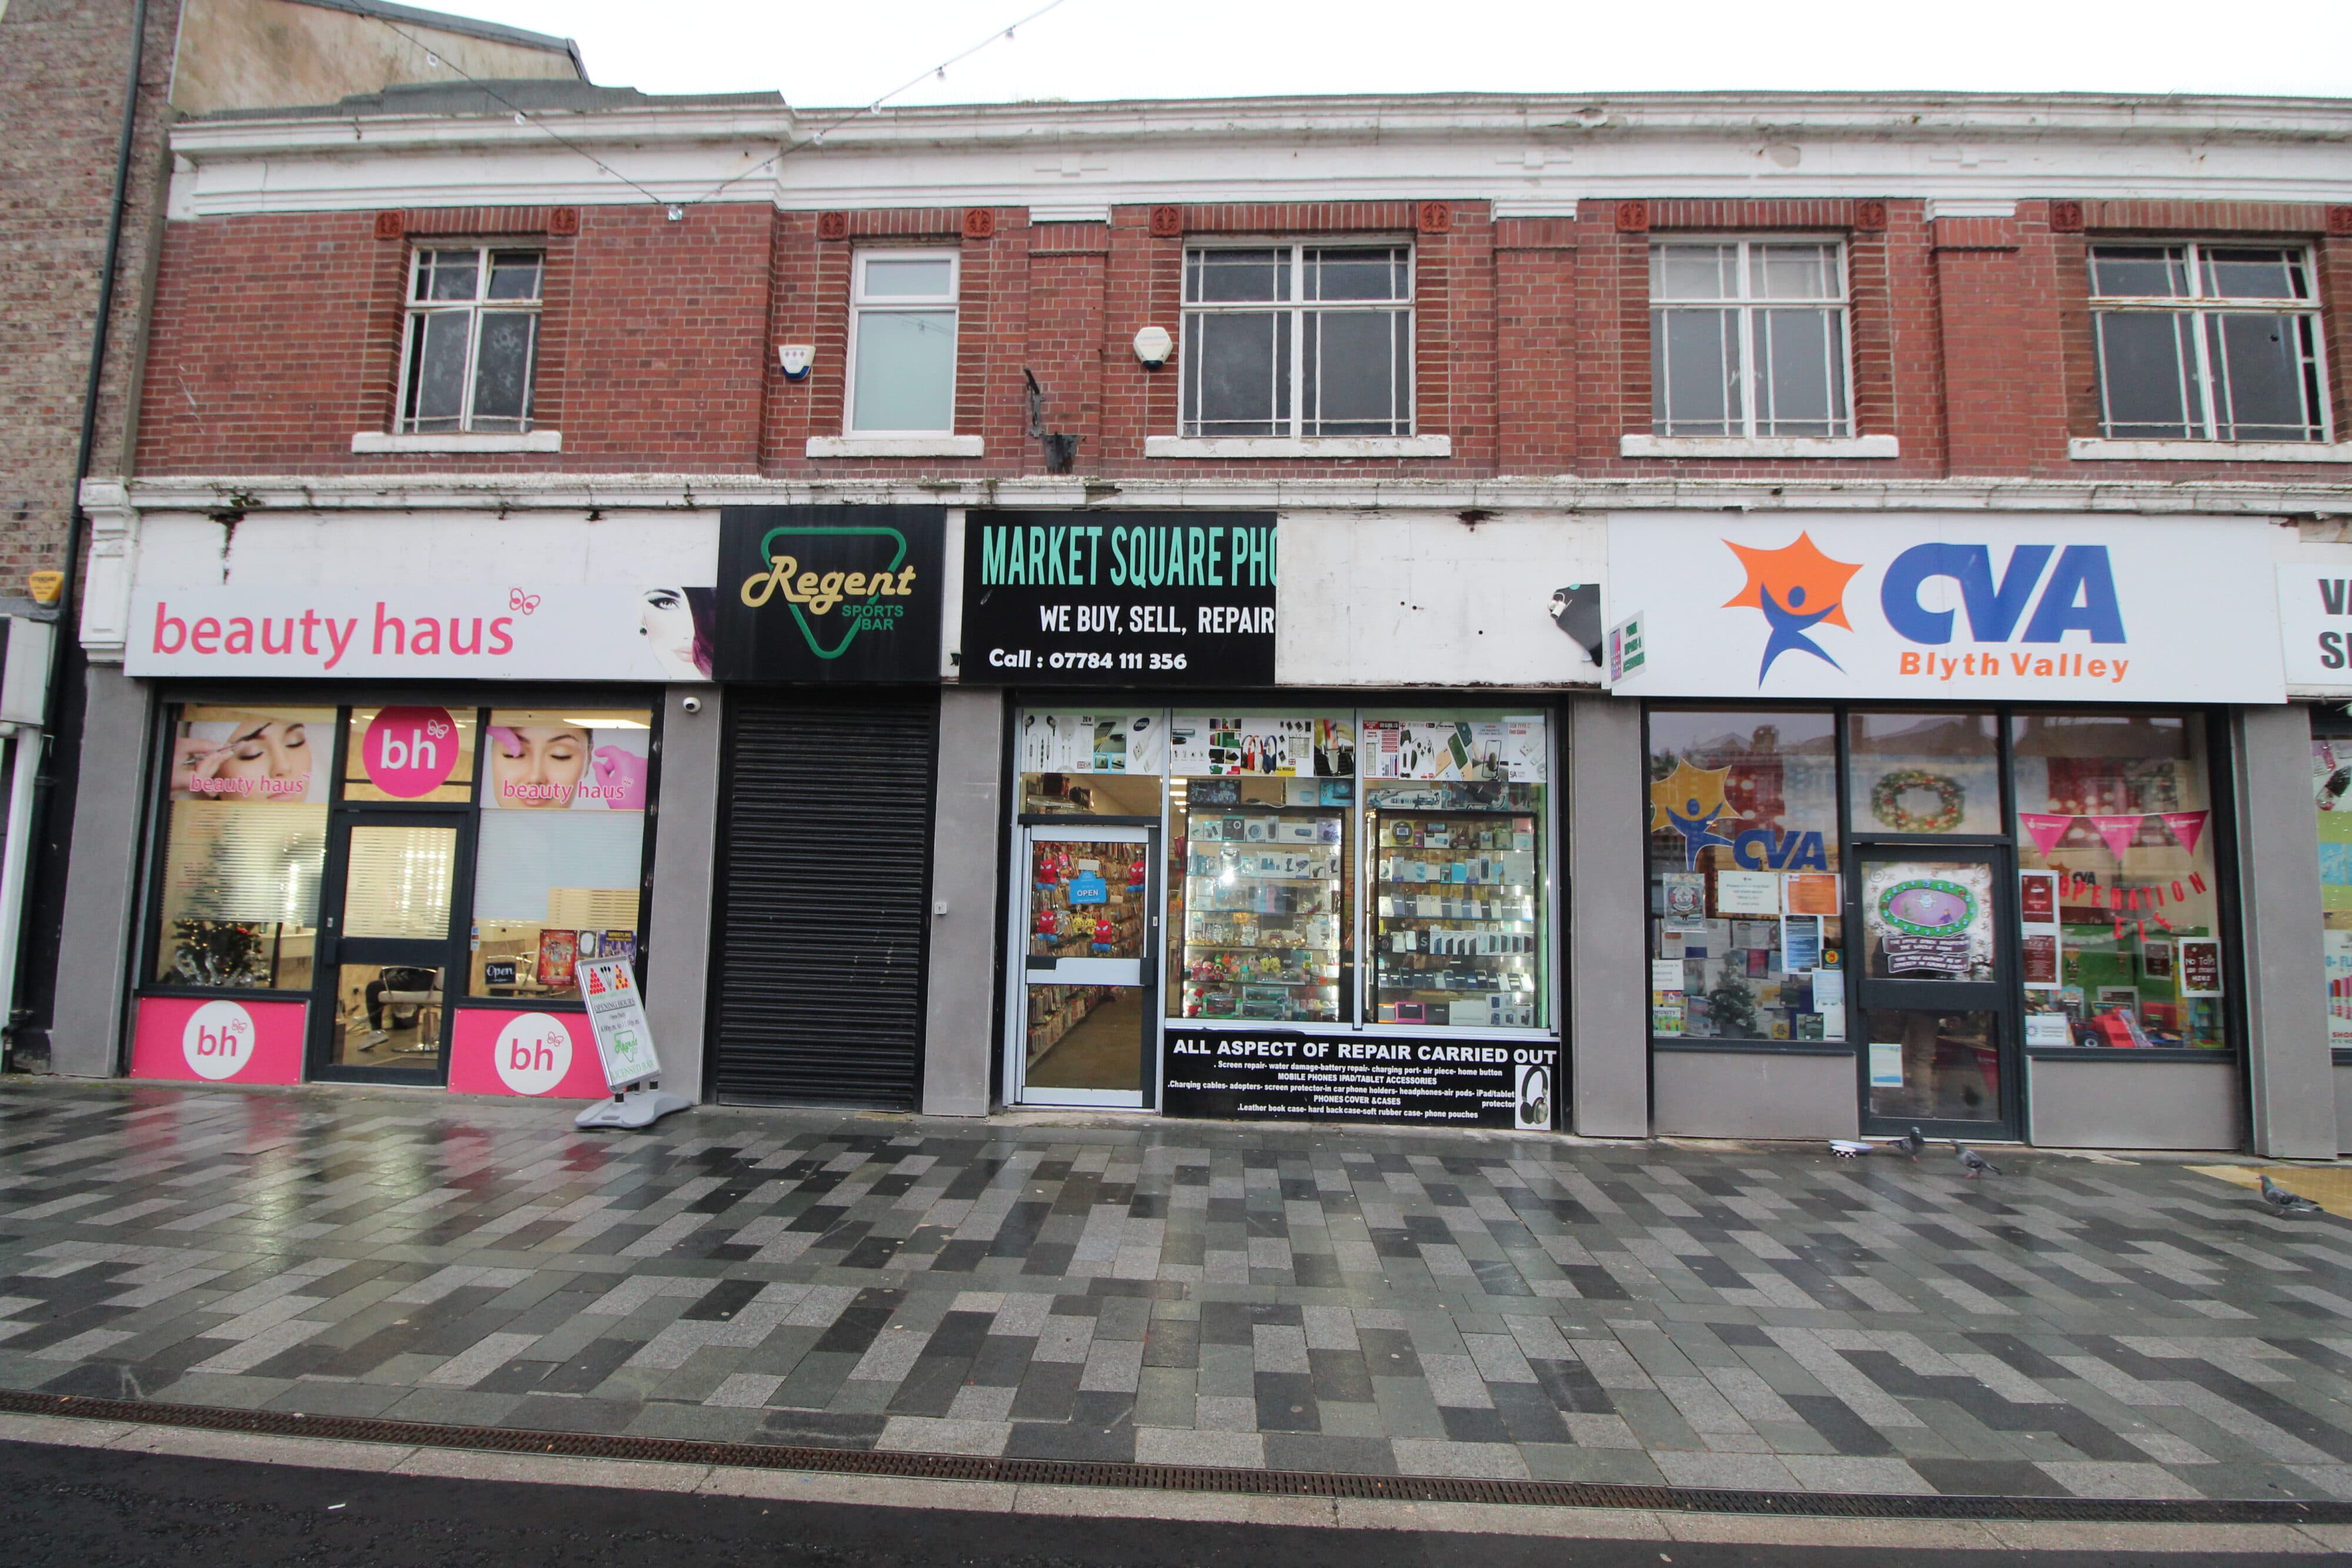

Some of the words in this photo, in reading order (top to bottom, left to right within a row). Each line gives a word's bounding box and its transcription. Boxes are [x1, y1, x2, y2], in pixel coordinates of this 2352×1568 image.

[982, 526, 1103, 586] MARKET
[1110, 526, 1224, 589] SQUARE
[741, 555, 917, 616] Regent
[1880, 542, 2127, 646] CVA
[842, 604, 904, 617] SPORTS
[1040, 605, 1071, 633] WE
[1077, 606, 1122, 635] BUY,
[1130, 606, 1187, 636] SELL,
[1198, 607, 1275, 634] REPAIR
[152, 601, 358, 670] beauty
[372, 601, 514, 656] haus
[862, 618, 894, 631] BAR
[989, 648, 1031, 668] Call
[1049, 652, 1113, 670] 07784
[1119, 653, 1142, 670] 111
[1149, 653, 1187, 670] 356
[1900, 651, 1999, 681] Blyth
[2010, 653, 2129, 683] Valley
[381, 729, 436, 770] bh
[190, 774, 255, 795] beauty
[260, 774, 303, 793] haus
[503, 780, 572, 803] beauty
[578, 781, 624, 799] haus
[1733, 828, 1828, 871] CVA
[486, 965, 514, 978] Open
[594, 1001, 617, 1012] OPENING
[617, 997, 635, 1008] HOURS
[197, 1025, 237, 1057] bh
[615, 1038, 637, 1054] Regent
[1173, 1039, 1211, 1054] ALL
[1217, 1041, 1297, 1057] ASPECT
[1303, 1042, 1329, 1058] OF
[1338, 1044, 1412, 1060] REPAIR
[1418, 1045, 1508, 1063] CARRIED
[1513, 1049, 1557, 1065] OUT
[510, 1038, 553, 1071] bh
[1218, 1060, 1242, 1069] Screen
[1244, 1061, 1267, 1071] repair-
[1347, 1065, 1369, 1073] repair-
[1371, 1065, 1402, 1075] charging
[1404, 1066, 1422, 1075] port-
[1434, 1067, 1456, 1076] piece-
[1479, 1068, 1503, 1076] button
[1278, 1072, 1306, 1081] MOBILE
[1307, 1073, 1337, 1082] PHONES
[1339, 1074, 1384, 1084] IPAD/TABLET
[1385, 1076, 1437, 1085] ACCESSORIES
[1202, 1081, 1228, 1089] cables-
[1345, 1085, 1367, 1094] phone
[1369, 1086, 1398, 1095] holders-
[1455, 1089, 1475, 1098] pods-
[1476, 1089, 1515, 1098] iPad/tablet
[1313, 1095, 1344, 1103] PHONES
[1344, 1095, 1369, 1104] COVER
[1371, 1096, 1401, 1105] &CASES
[1268, 1104, 1286, 1112] book
[1308, 1105, 1324, 1114] hard
[1326, 1105, 1344, 1114] back
[1378, 1108, 1402, 1116] rubber
[1424, 1109, 1446, 1118] phone
[1448, 1111, 1478, 1119] pouches
[1482, 1100, 1515, 1109] protector
